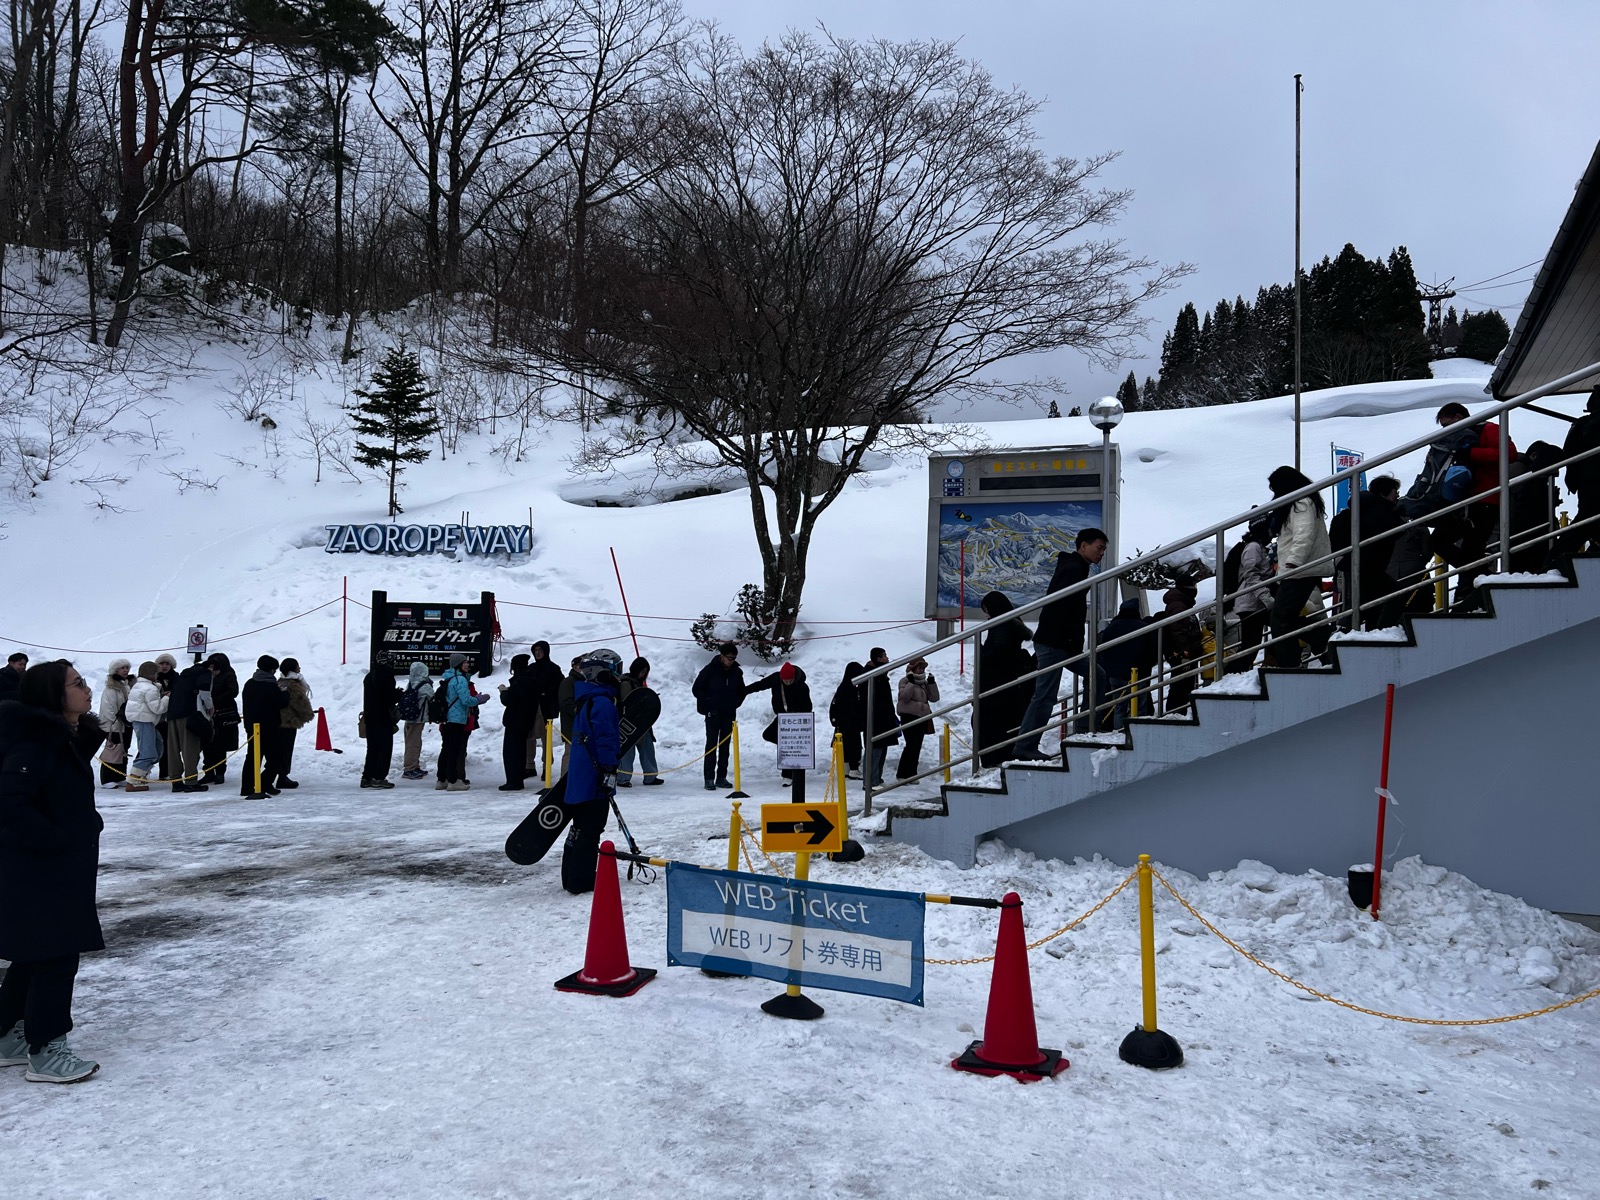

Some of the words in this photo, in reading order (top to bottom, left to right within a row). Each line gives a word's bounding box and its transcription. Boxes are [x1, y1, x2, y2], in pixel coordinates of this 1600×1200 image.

[462, 524, 530, 554] WAY
[383, 628, 482, 643] 蔵王ロープウェイ
[714, 879, 776, 911] WEB
[781, 887, 870, 924] Ticket
[709, 926, 751, 949] WEB
[758, 932, 883, 972] リフト券専用
